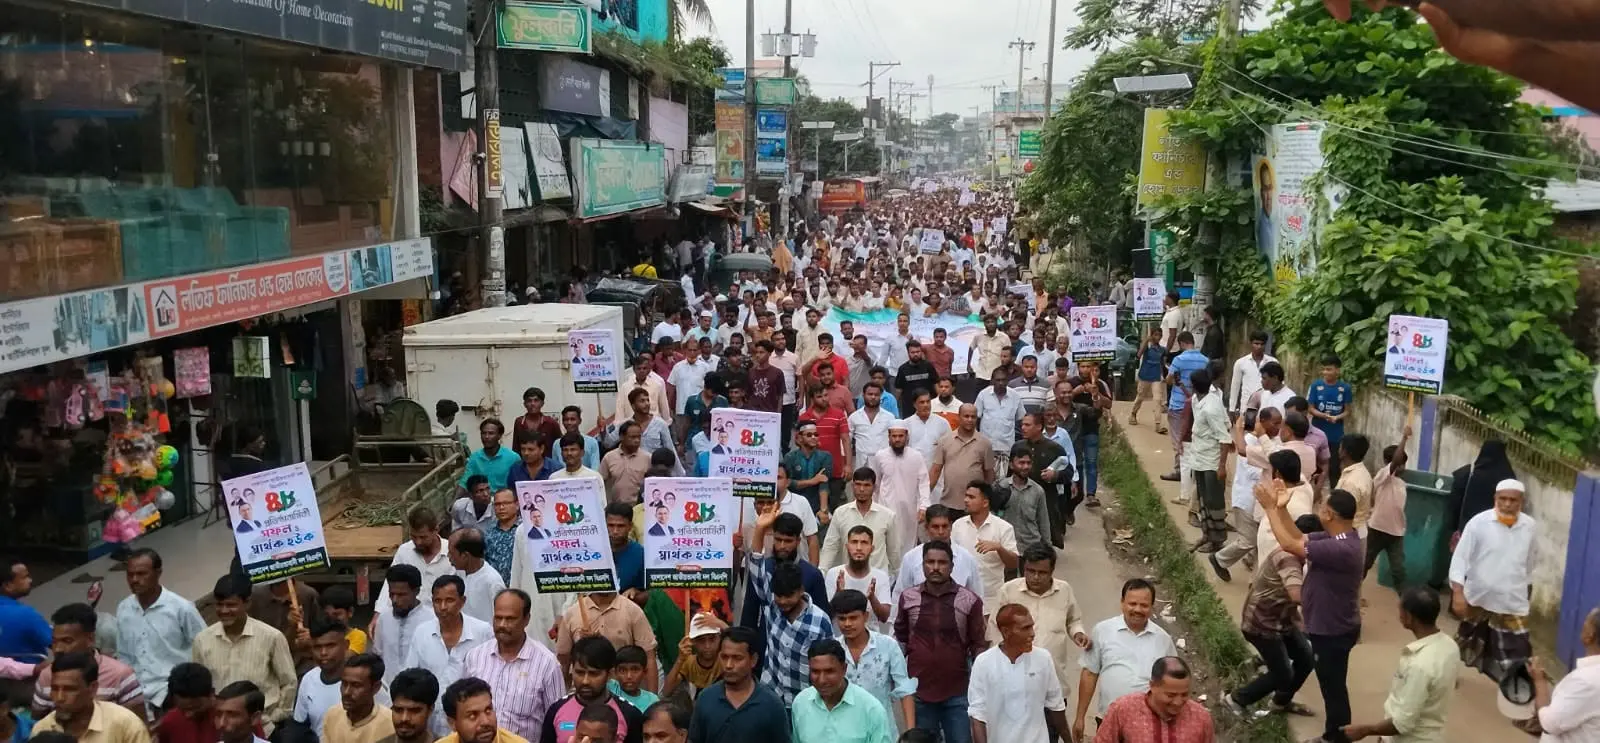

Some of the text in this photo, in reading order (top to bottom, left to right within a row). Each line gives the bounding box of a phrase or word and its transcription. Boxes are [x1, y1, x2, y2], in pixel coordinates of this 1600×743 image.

[274, 0, 286, 17] Of
[288, 0, 311, 18] Home
[313, 5, 354, 27] Decoration
[180, 279, 215, 313] লতিফ
[216, 271, 257, 305] ফার্নিচার
[258, 275, 275, 297] এন্ড
[275, 271, 294, 294] হোম
[1412, 333, 1433, 348] ৪৮
[740, 429, 765, 447] ৪৮
[730, 456, 755, 465] সফল
[747, 467, 771, 476] হউক
[265, 490, 297, 513] ৪৮
[555, 502, 584, 525] ৪৮
[684, 501, 716, 524] ৪৮
[261, 524, 292, 538] সফল
[287, 532, 315, 547] হউক
[550, 538, 580, 549] সফল
[672, 537, 704, 547] সফল
[576, 550, 602, 563] হউক
[696, 548, 725, 560] হউক
